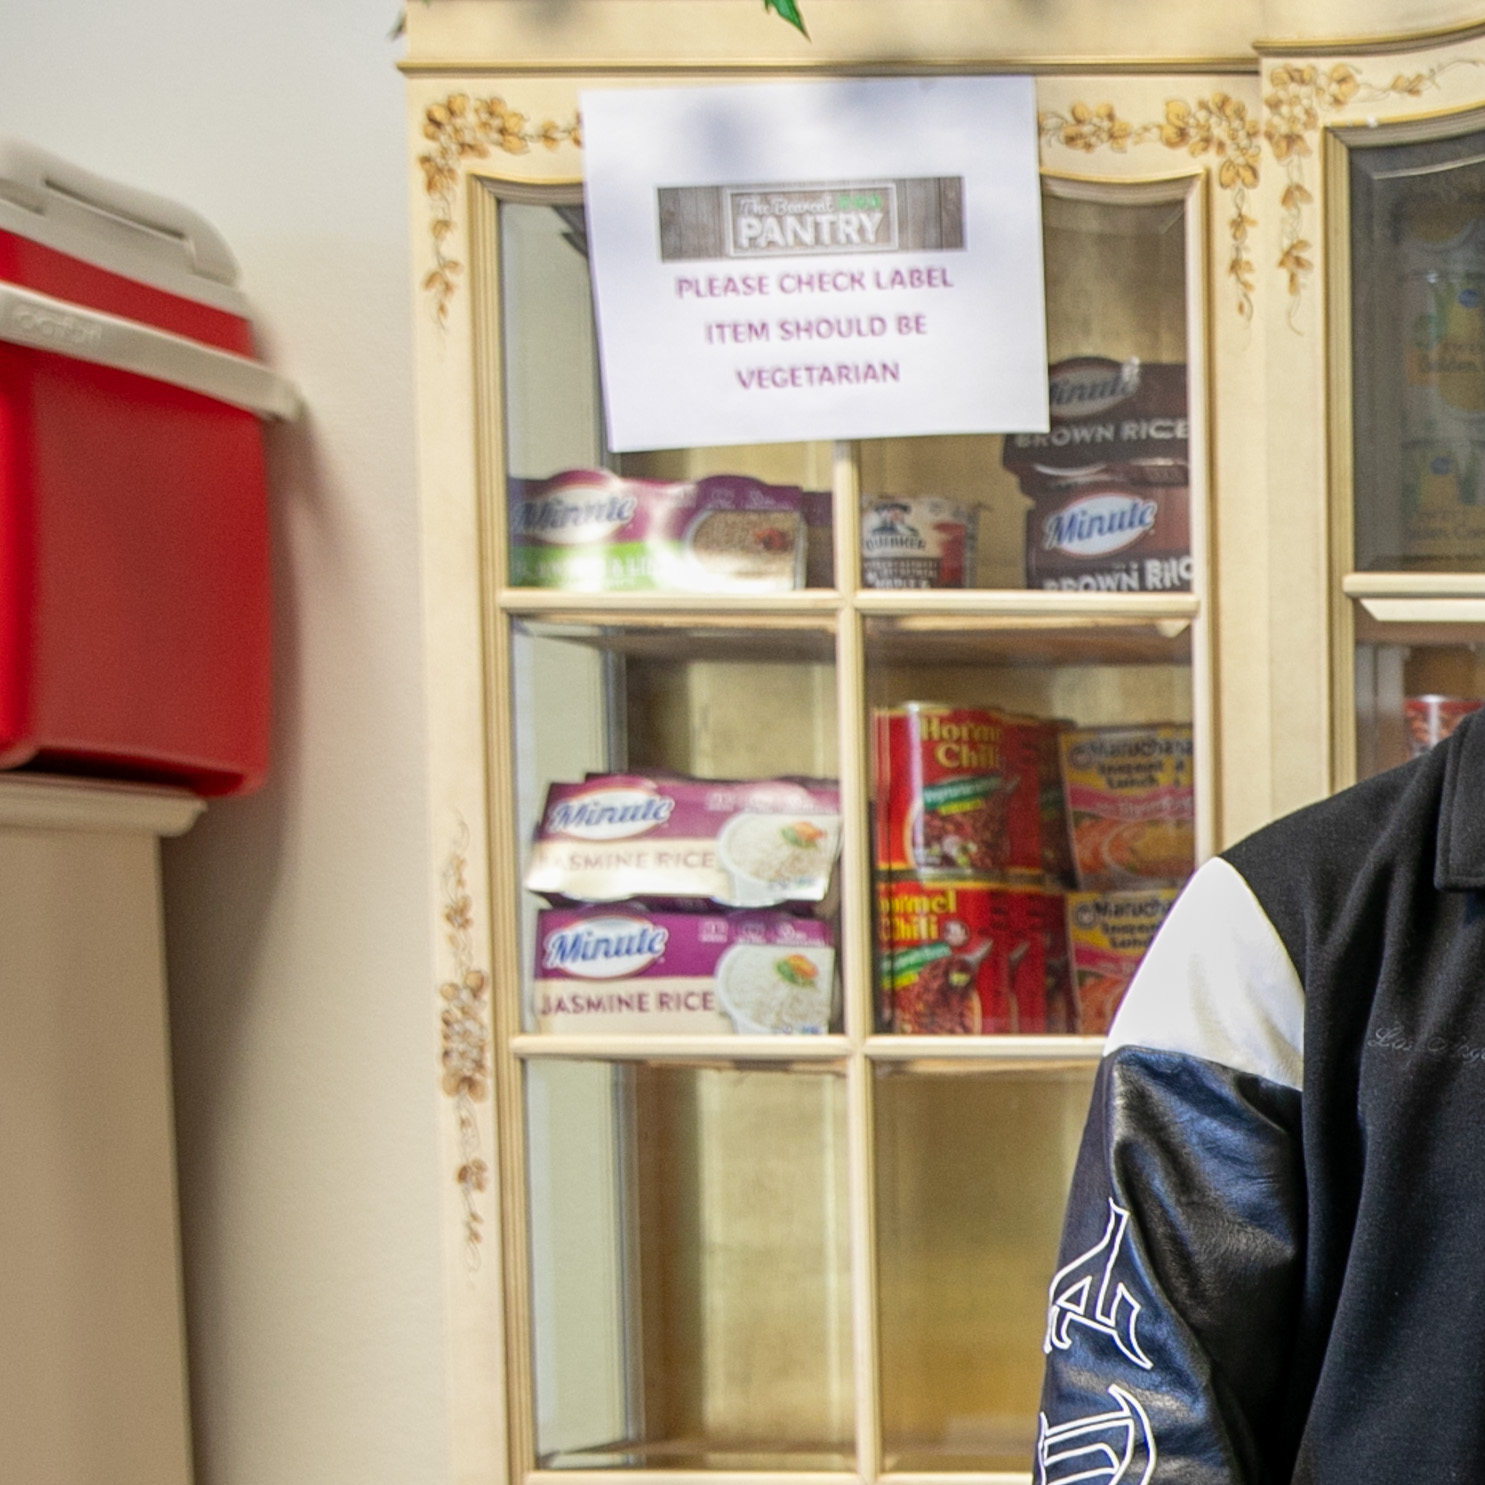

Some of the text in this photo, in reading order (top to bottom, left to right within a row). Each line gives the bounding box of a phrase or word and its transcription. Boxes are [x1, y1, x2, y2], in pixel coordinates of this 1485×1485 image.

[739, 212, 883, 249] PANTRY
[676, 267, 954, 299] PLEASE CHECK LABEL
[705, 314, 928, 344] ITEM SHOULD BE
[735, 362, 901, 390] VEGETARIAN
[1043, 499, 1158, 550] Minute
[547, 795, 675, 832] Minute
[655, 850, 715, 869] RICE
[543, 926, 669, 969] Minute
[540, 992, 715, 1016] JASMINE RICE
